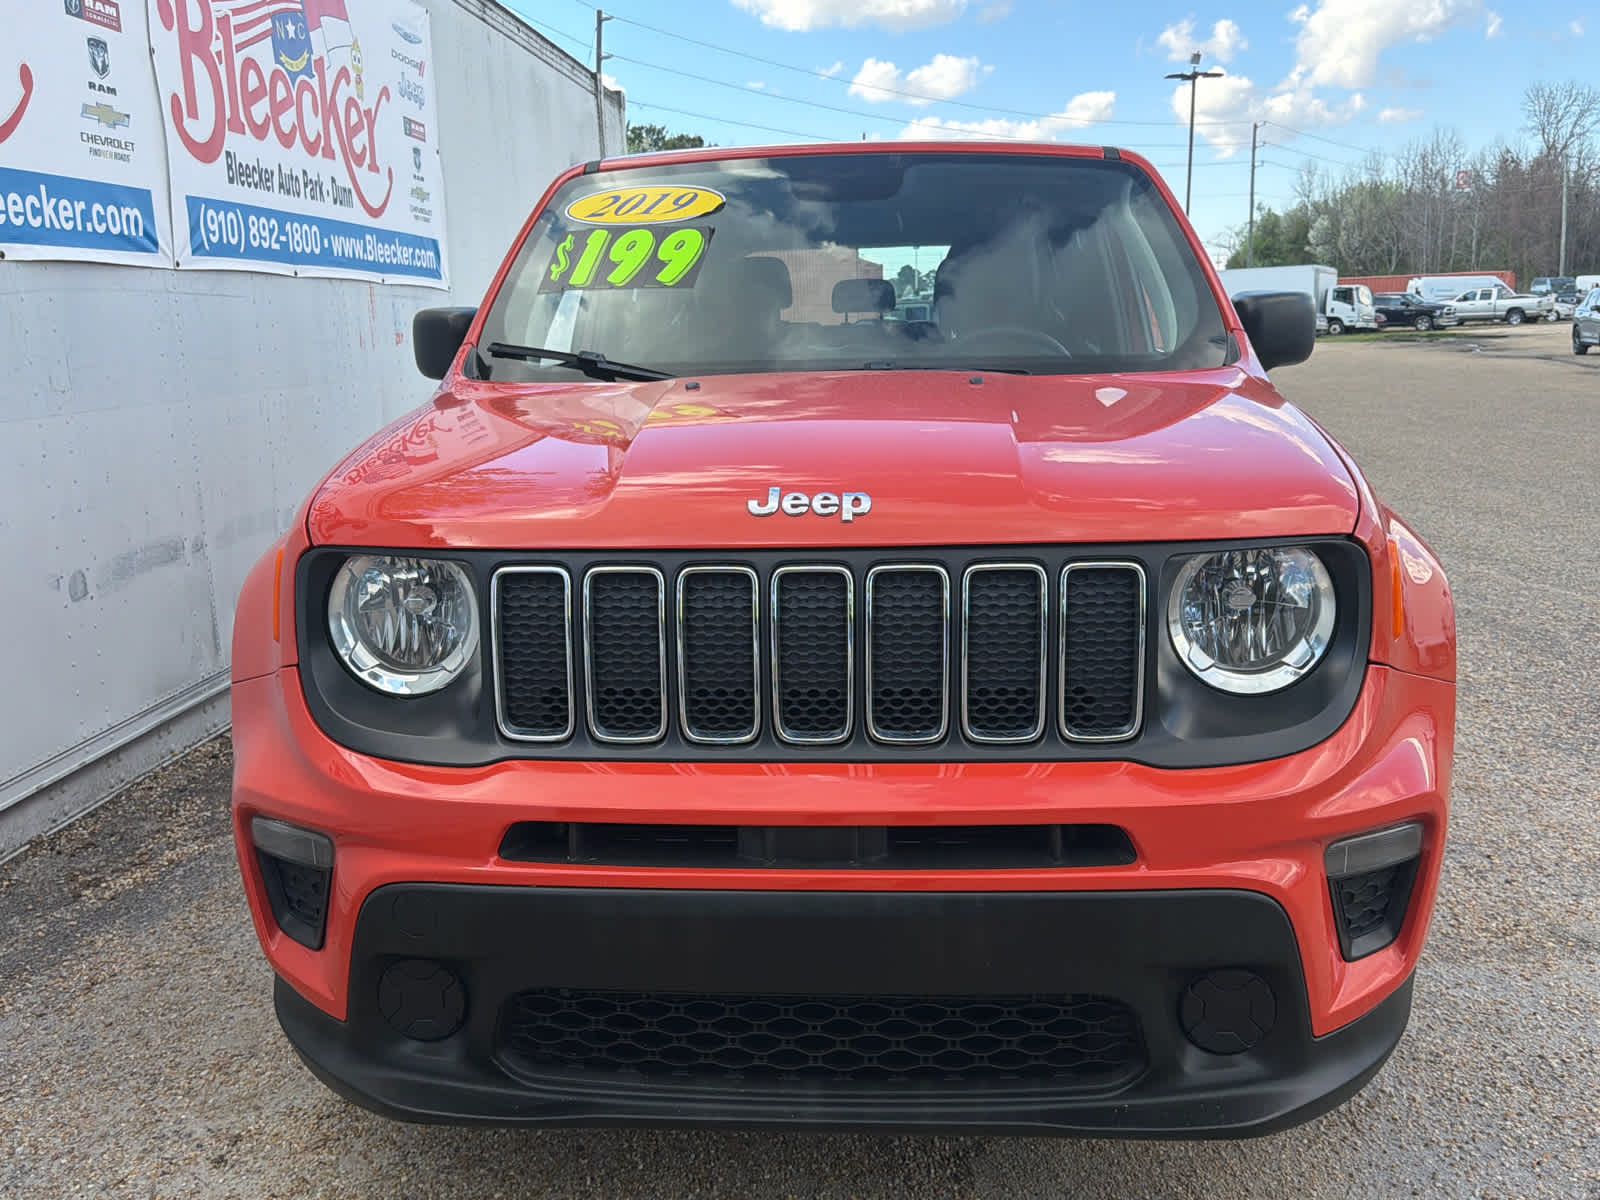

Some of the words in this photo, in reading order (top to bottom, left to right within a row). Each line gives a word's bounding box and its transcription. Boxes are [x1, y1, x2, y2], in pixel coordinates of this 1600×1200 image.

[88, 81, 117, 97] RAM
[157, 0, 393, 219] Bleecker
[80, 131, 136, 153] CHEVROLET
[225, 149, 275, 193] Bleecker
[278, 162, 302, 199] Auto
[302, 168, 326, 203] Park
[331, 175, 354, 209] Dunn
[585, 191, 699, 218] 2019
[200, 203, 245, 253] (910)
[248, 213, 321, 255] 892-1800
[330, 233, 437, 270] www.Bleecker.com
[550, 228, 705, 287] $199
[746, 486, 873, 523] Jeep
